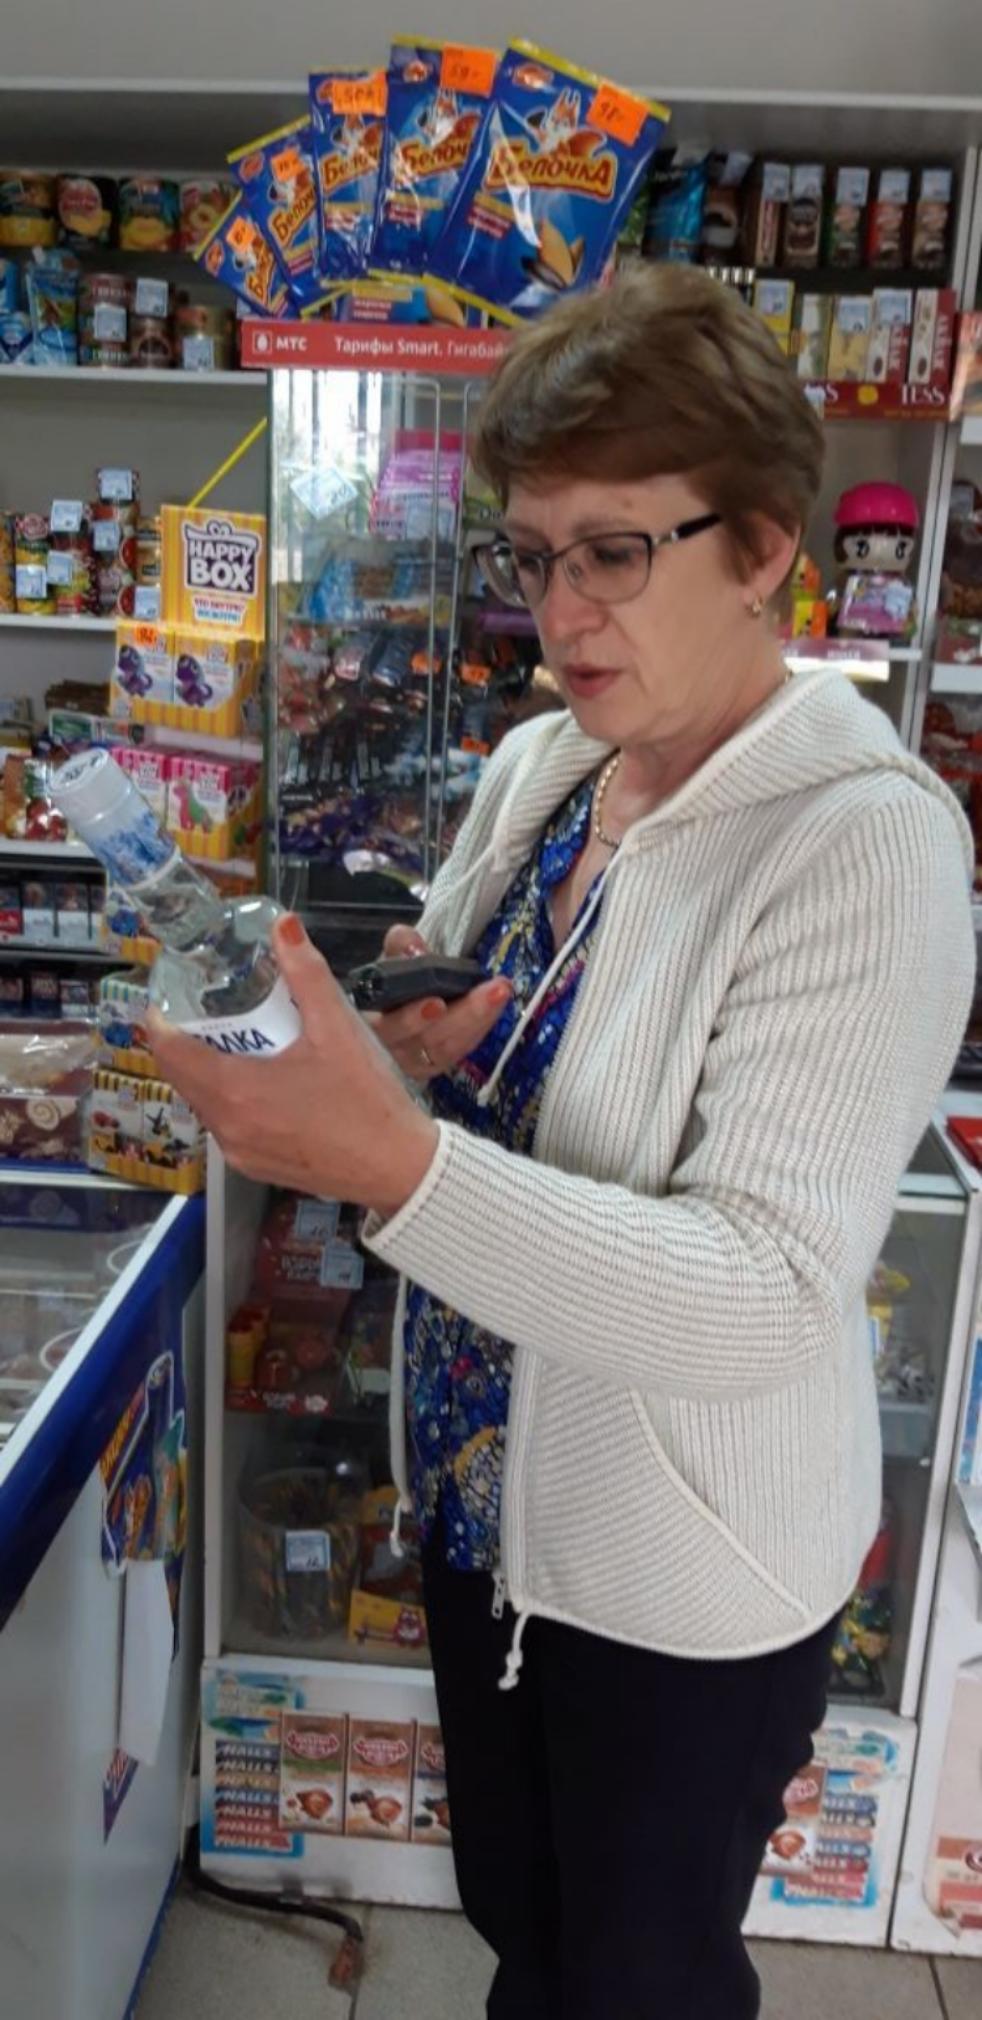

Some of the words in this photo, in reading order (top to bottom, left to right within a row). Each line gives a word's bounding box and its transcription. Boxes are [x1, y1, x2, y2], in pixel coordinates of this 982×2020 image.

[276, 337, 308, 351] МТС
[334, 336, 394, 356] Тарифы
[397, 338, 443, 355] Smart.
[189, 539, 253, 566] HAPPY
[190, 557, 252, 592] BOX
